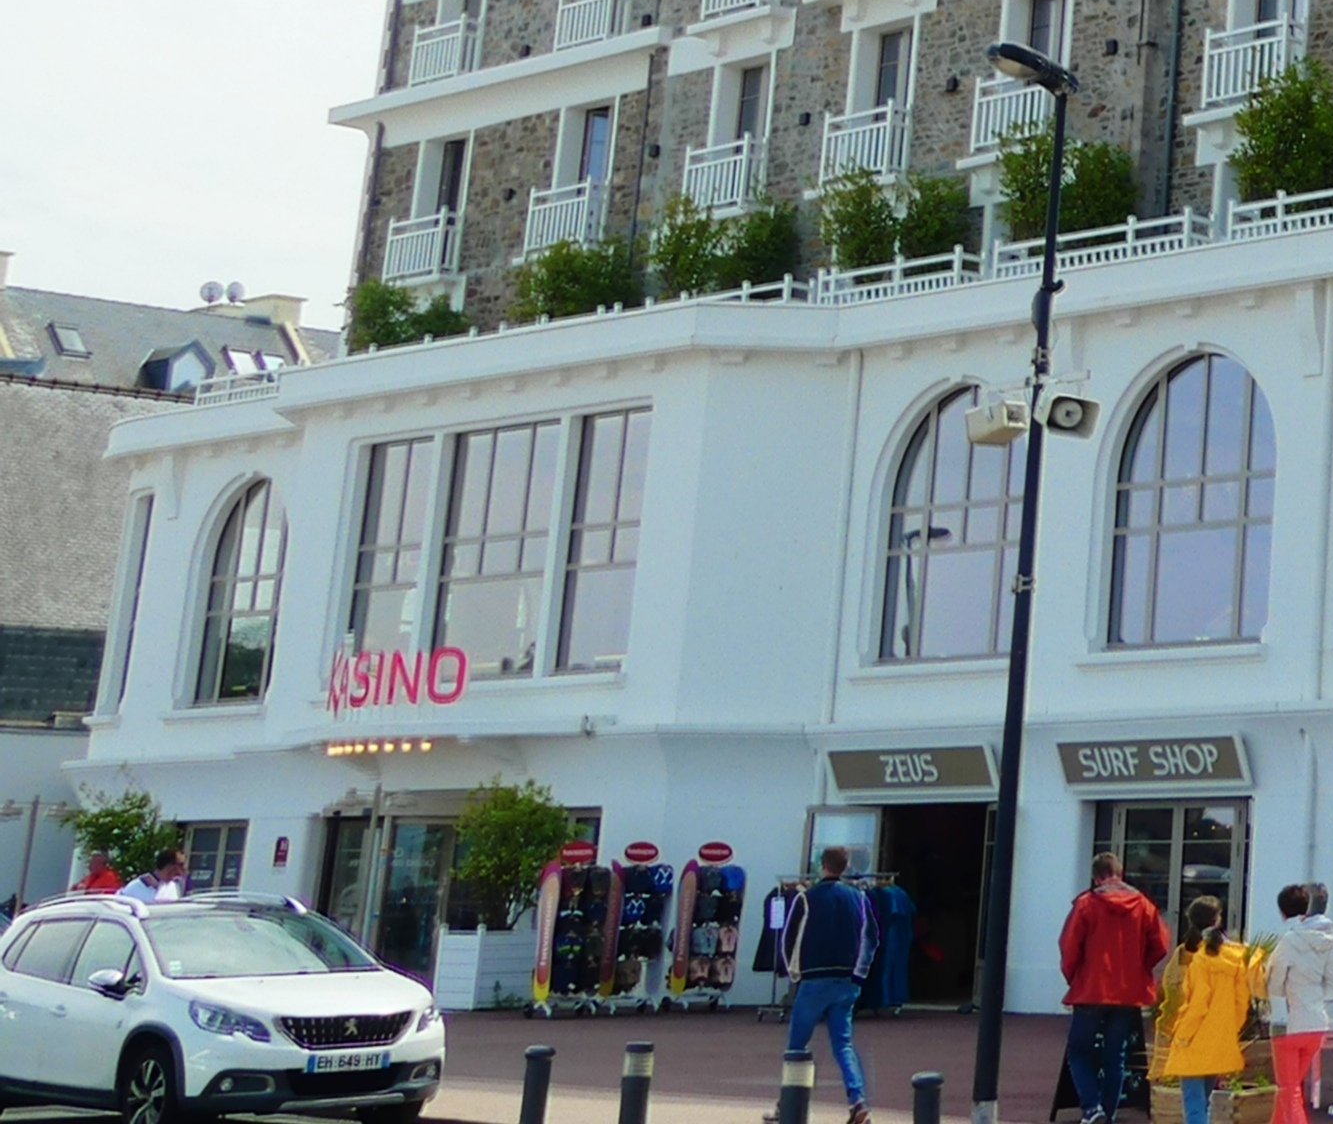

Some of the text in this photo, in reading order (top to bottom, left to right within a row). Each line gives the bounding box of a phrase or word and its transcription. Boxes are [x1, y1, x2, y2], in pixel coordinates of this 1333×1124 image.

[879, 753, 938, 784] ZEUS
[1078, 742, 1219, 778] SURF SHOP
